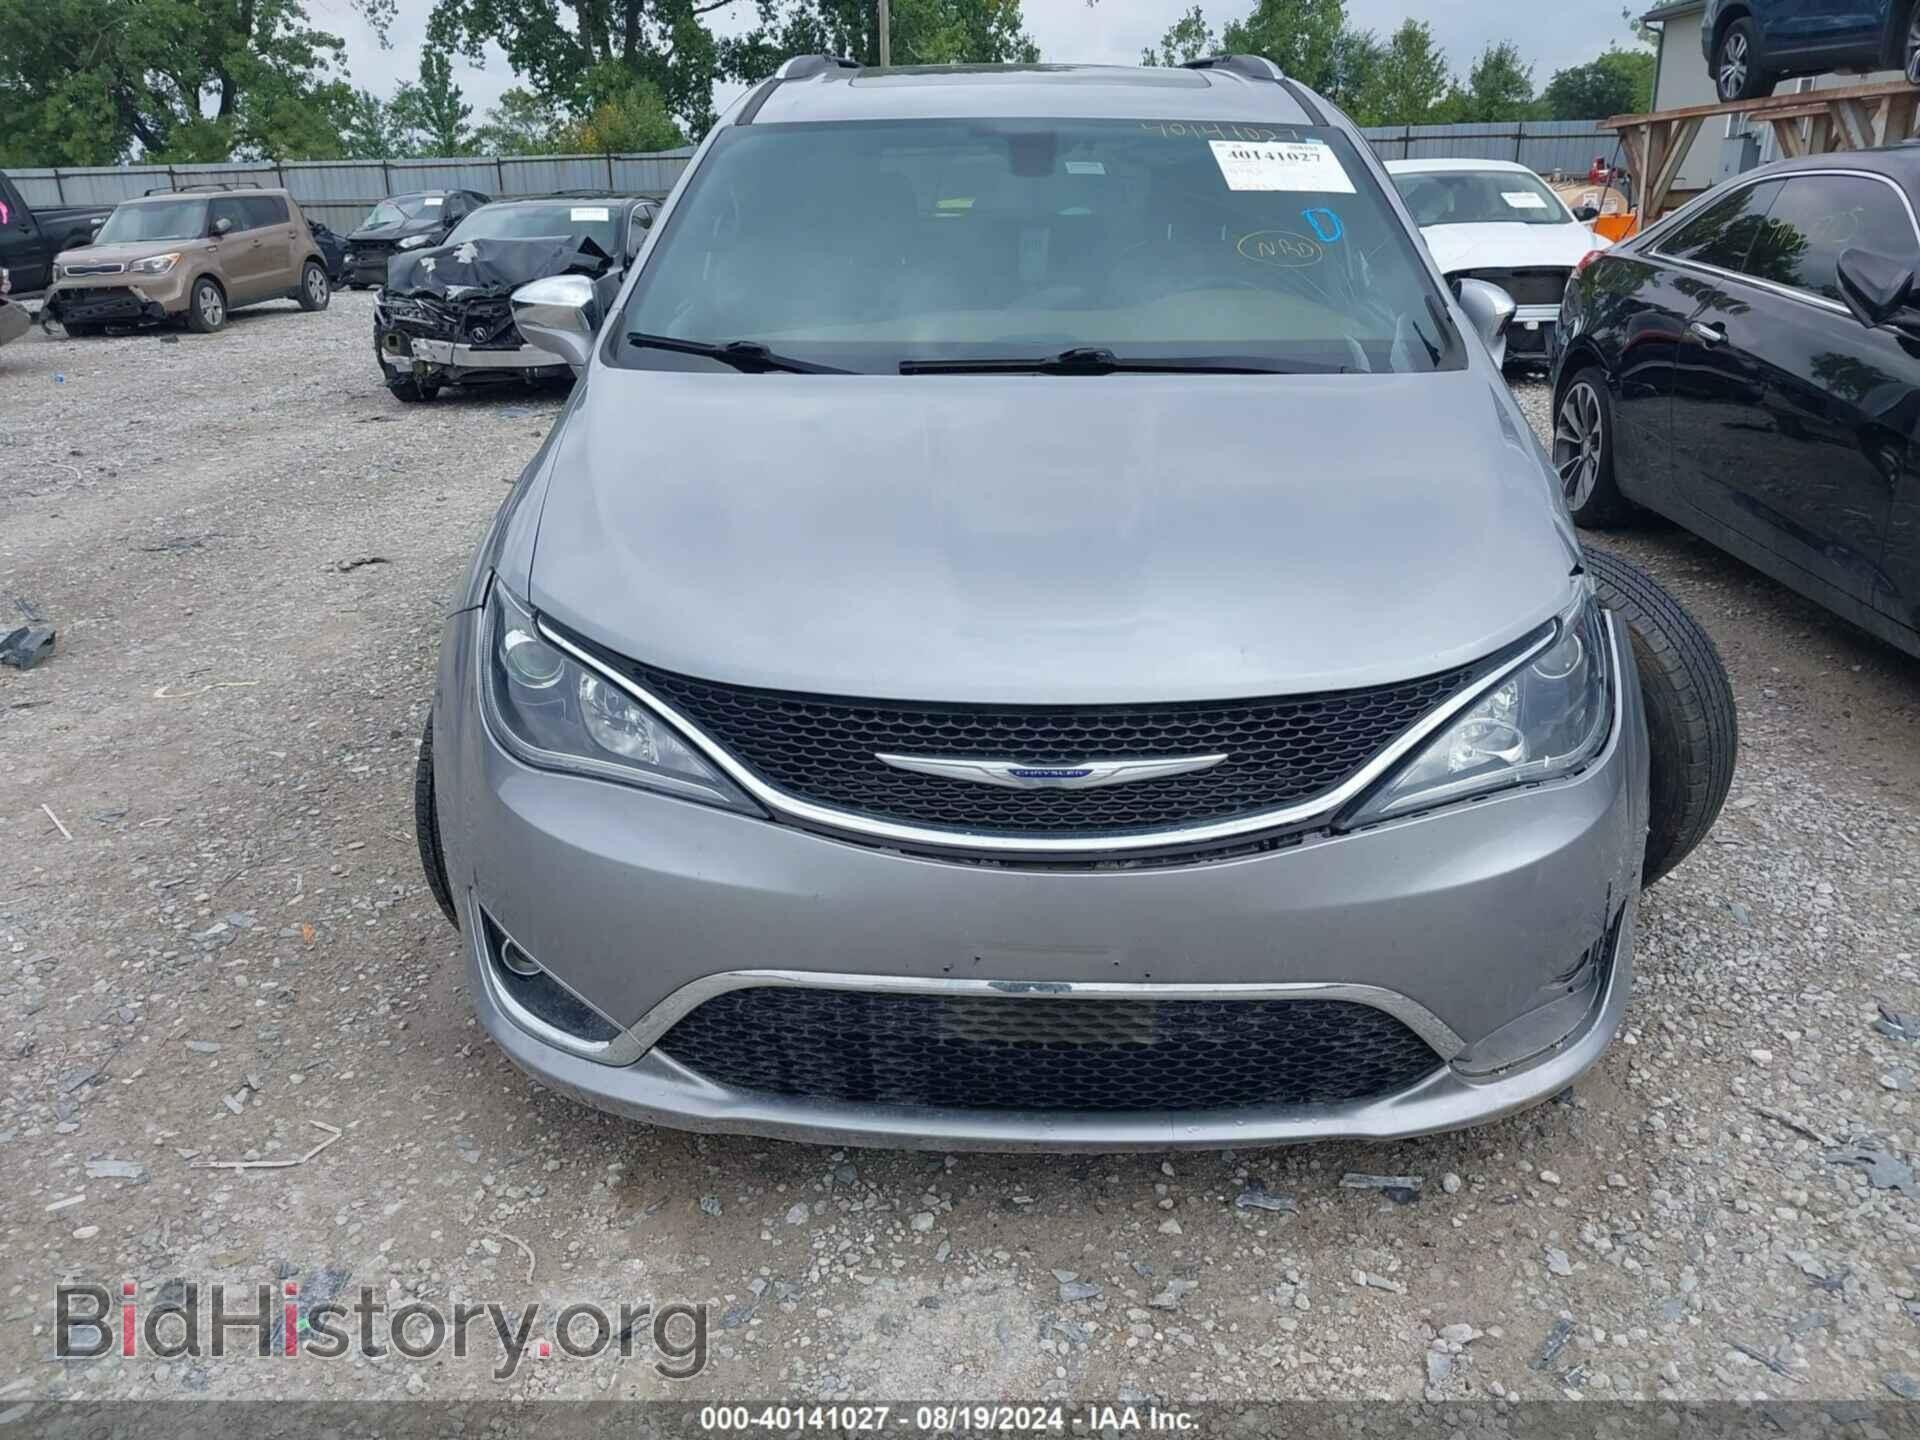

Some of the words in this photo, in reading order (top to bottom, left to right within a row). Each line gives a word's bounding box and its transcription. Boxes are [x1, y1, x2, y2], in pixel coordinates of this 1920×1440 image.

[1228, 150, 1321, 162] 40141027
[1301, 208, 1344, 242] D
[1014, 769, 1085, 777] CHRYSLER
